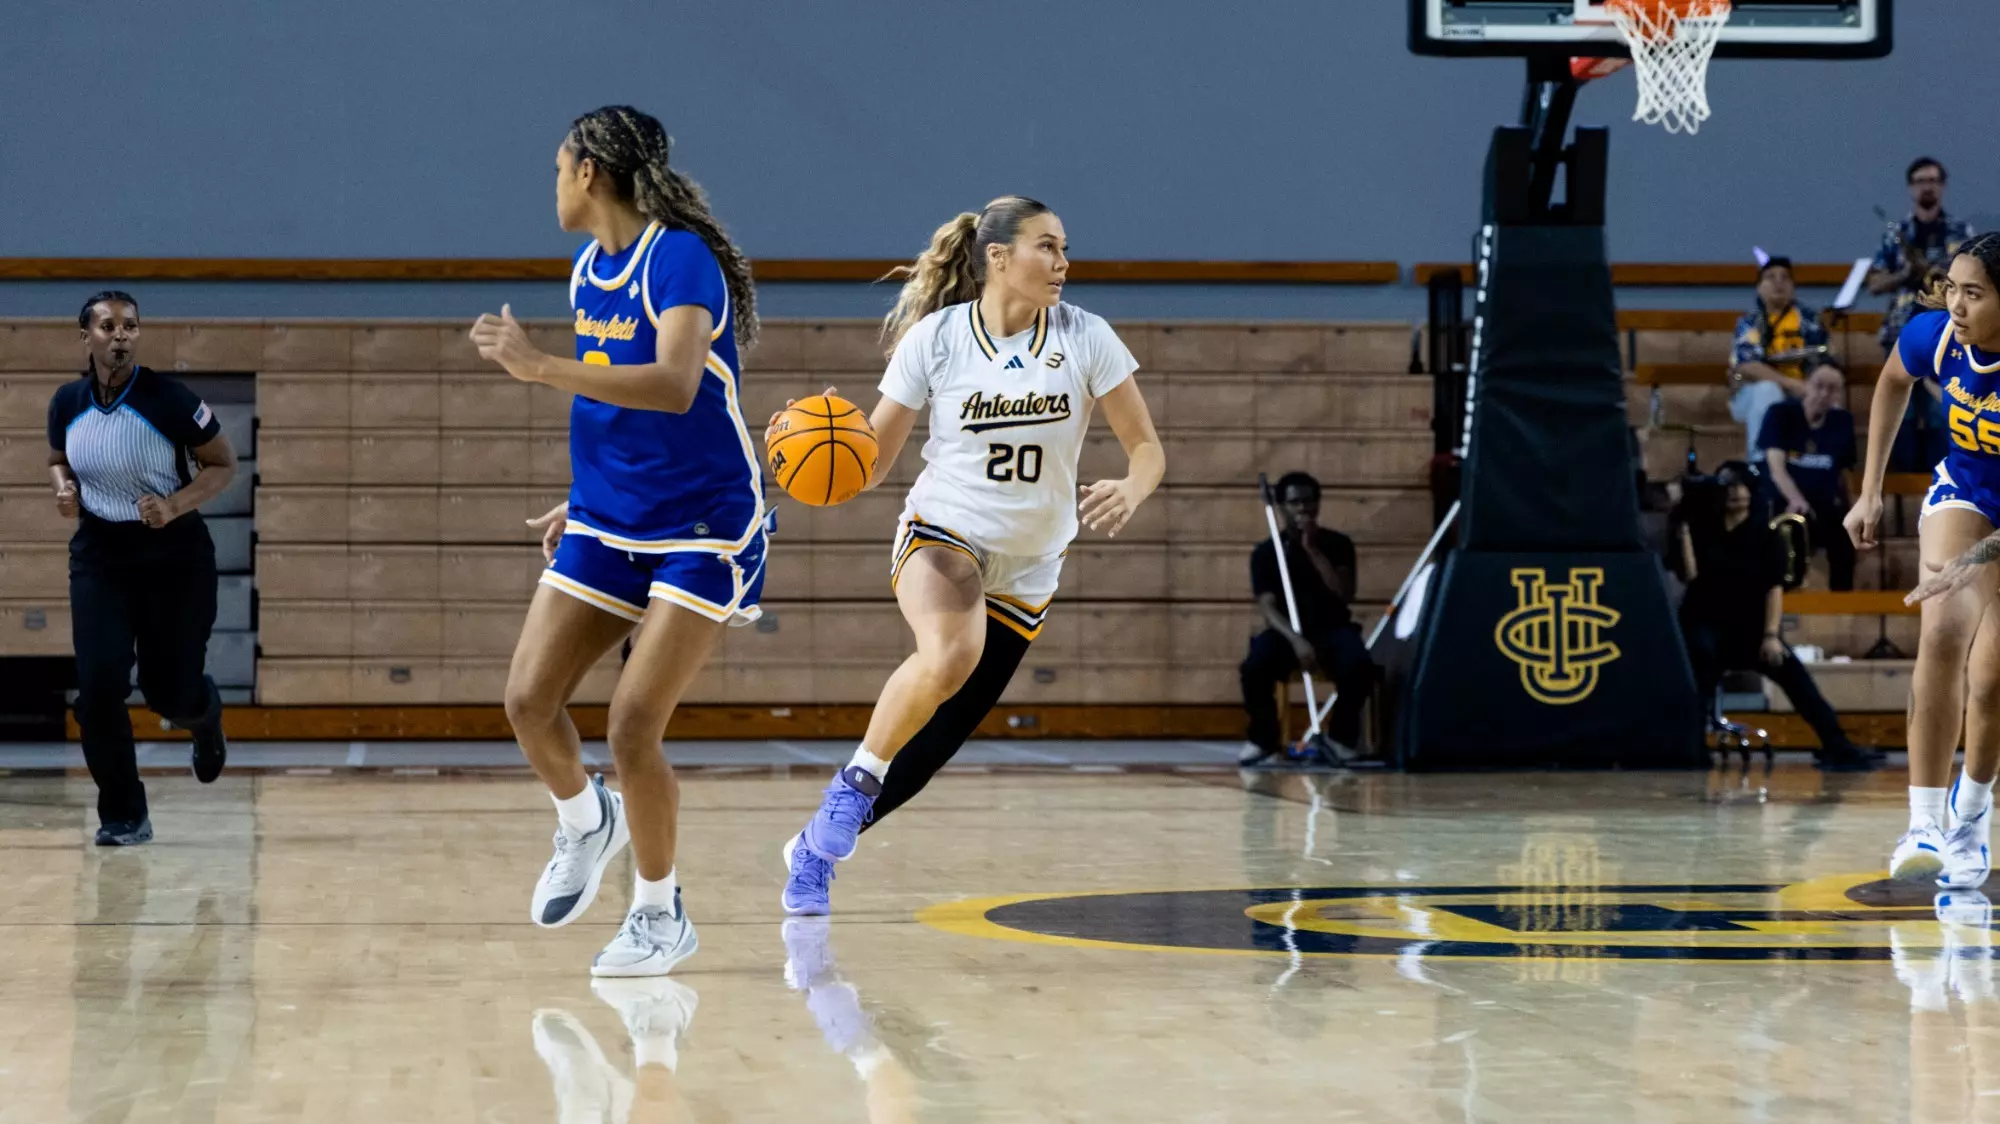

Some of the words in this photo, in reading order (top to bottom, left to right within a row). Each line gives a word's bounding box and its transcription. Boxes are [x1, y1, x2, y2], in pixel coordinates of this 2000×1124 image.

[959, 391, 1071, 421] Anteaters
[1949, 404, 2000, 455] 55
[987, 443, 1043, 483] 20
